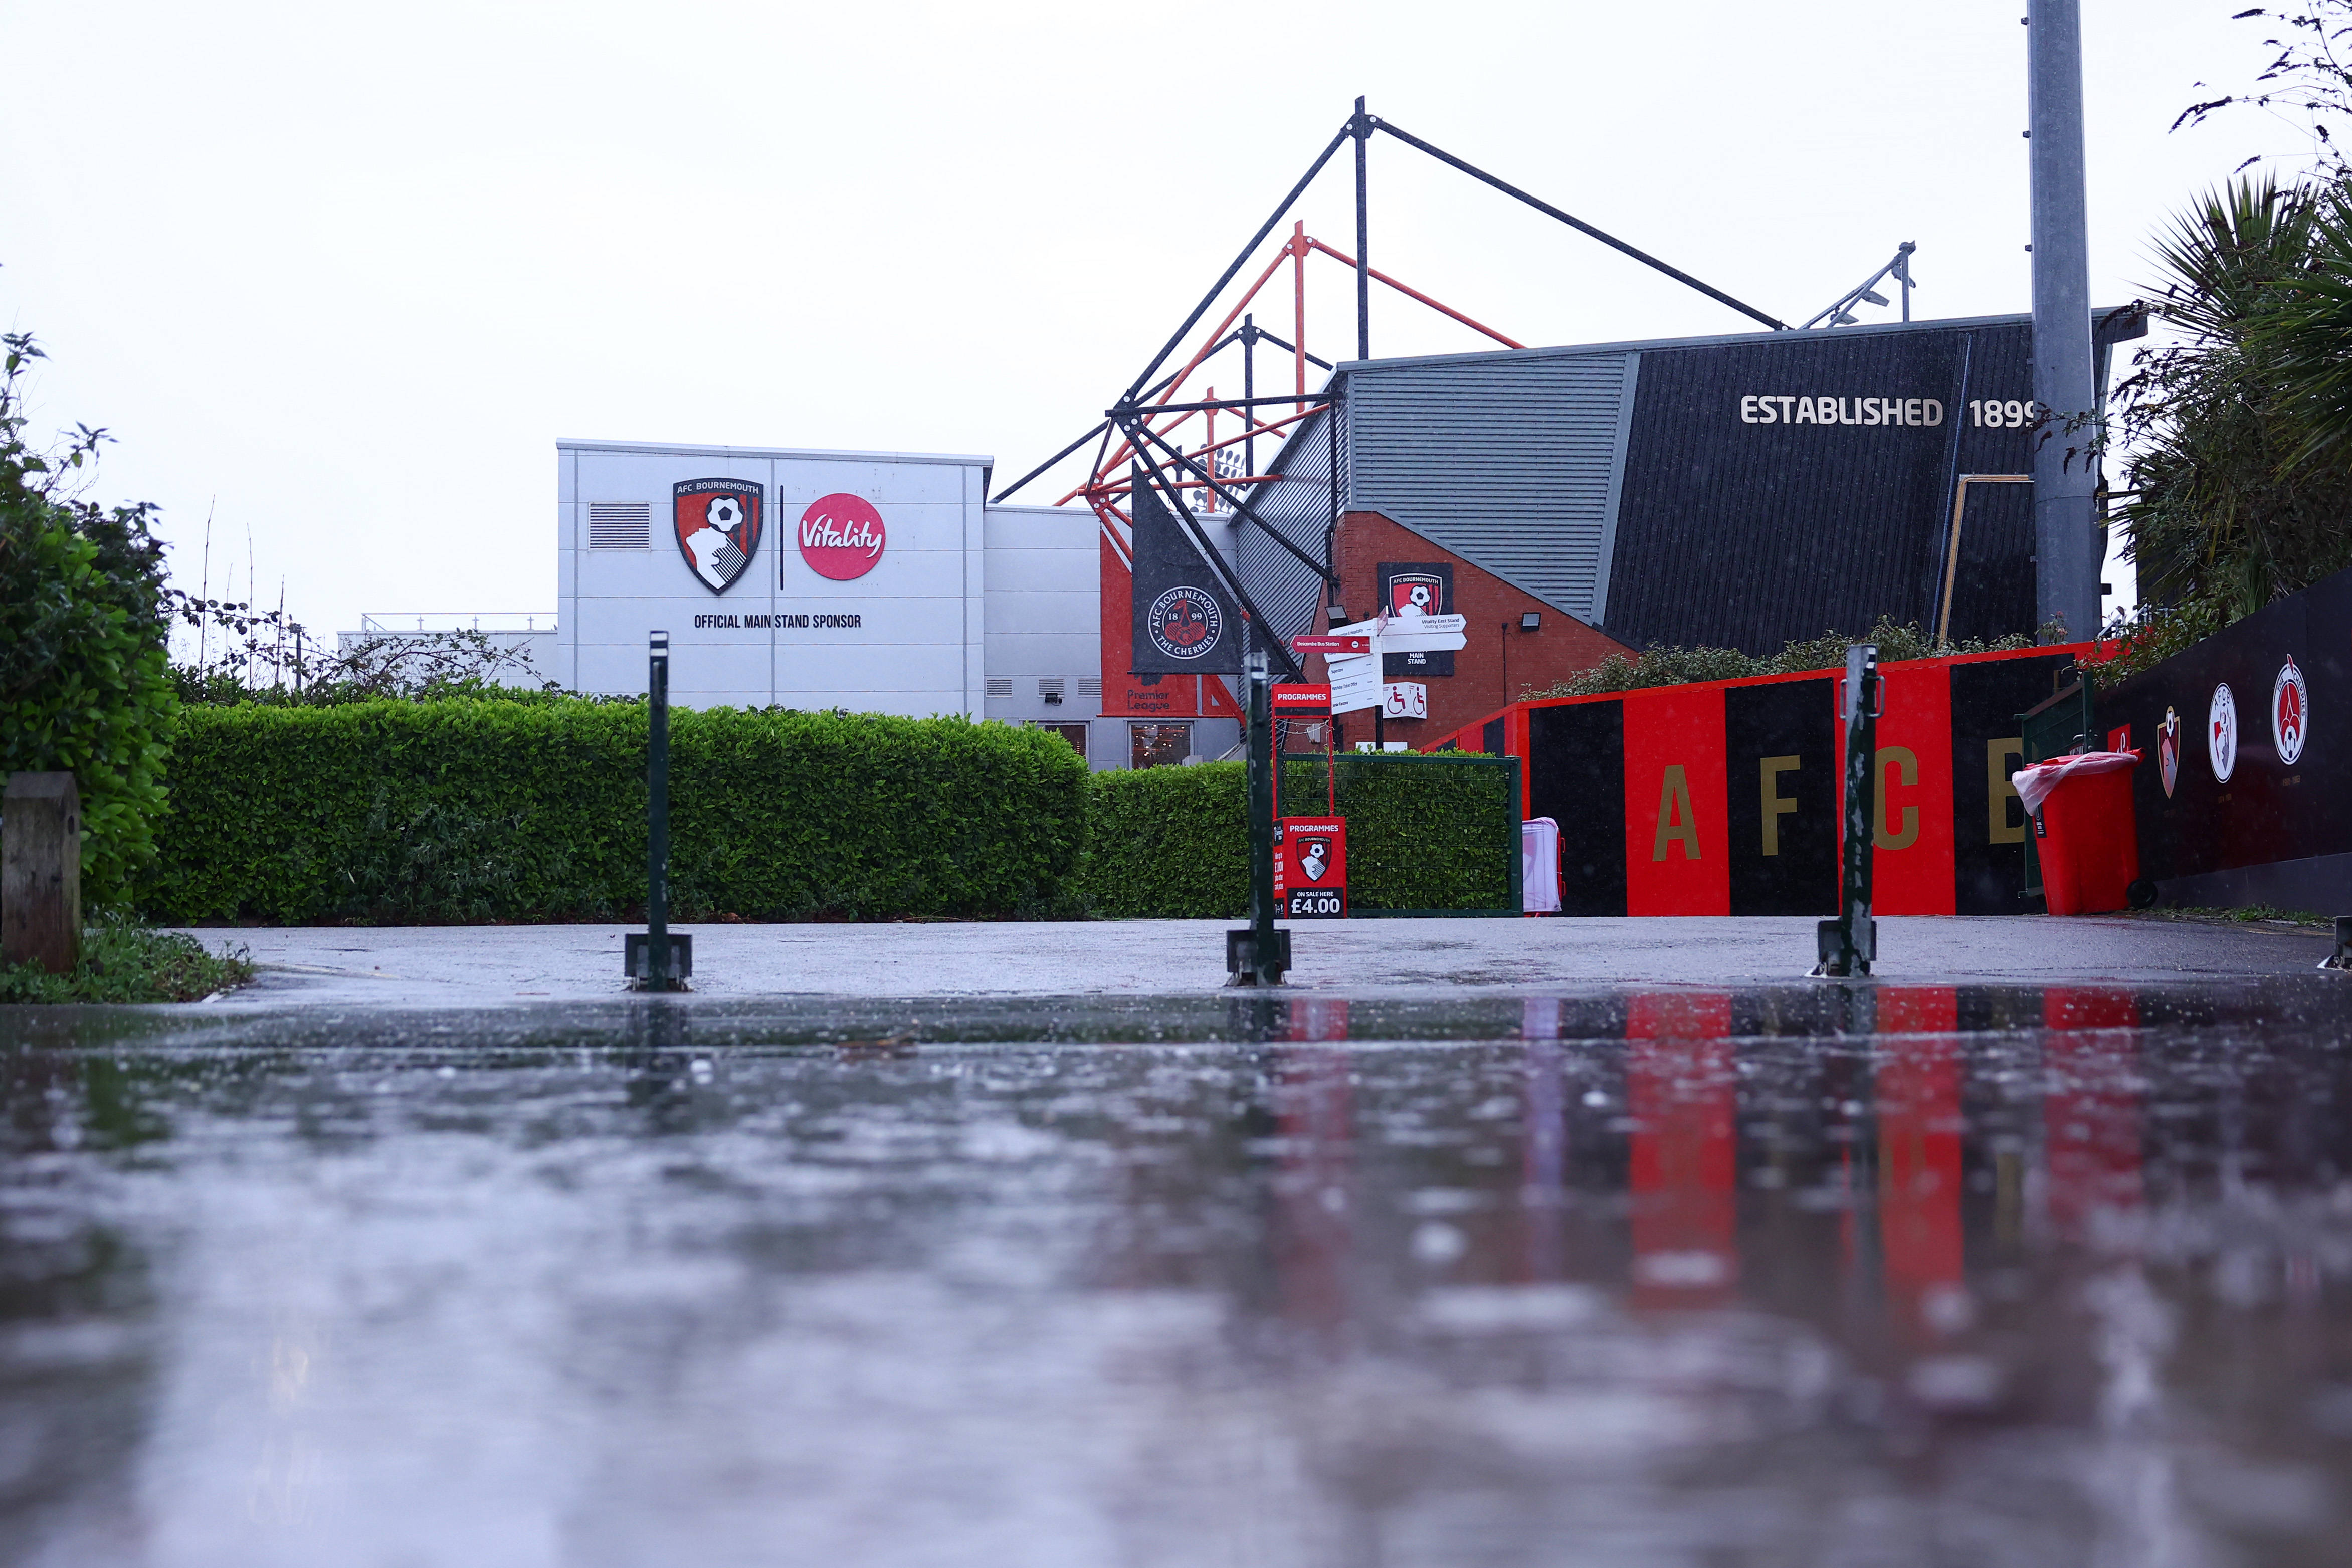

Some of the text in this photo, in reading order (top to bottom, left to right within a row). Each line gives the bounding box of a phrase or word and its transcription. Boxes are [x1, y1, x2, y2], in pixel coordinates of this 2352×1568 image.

[1740, 395, 1943, 427] ESTABLISHED
[677, 482, 759, 494] AFC BOURNEMOUTH
[802, 514, 883, 558] Vitality
[1153, 590, 1218, 627] AFC BOURNEMOUTH
[694, 614, 861, 628] OFFICIAL MAIN STAND SPONSOR
[1157, 635, 1214, 655] THE CHERRIES
[1127, 689, 1169, 699] Premier
[1128, 700, 1170, 712] League
[1291, 898, 1340, 914] £4.00
